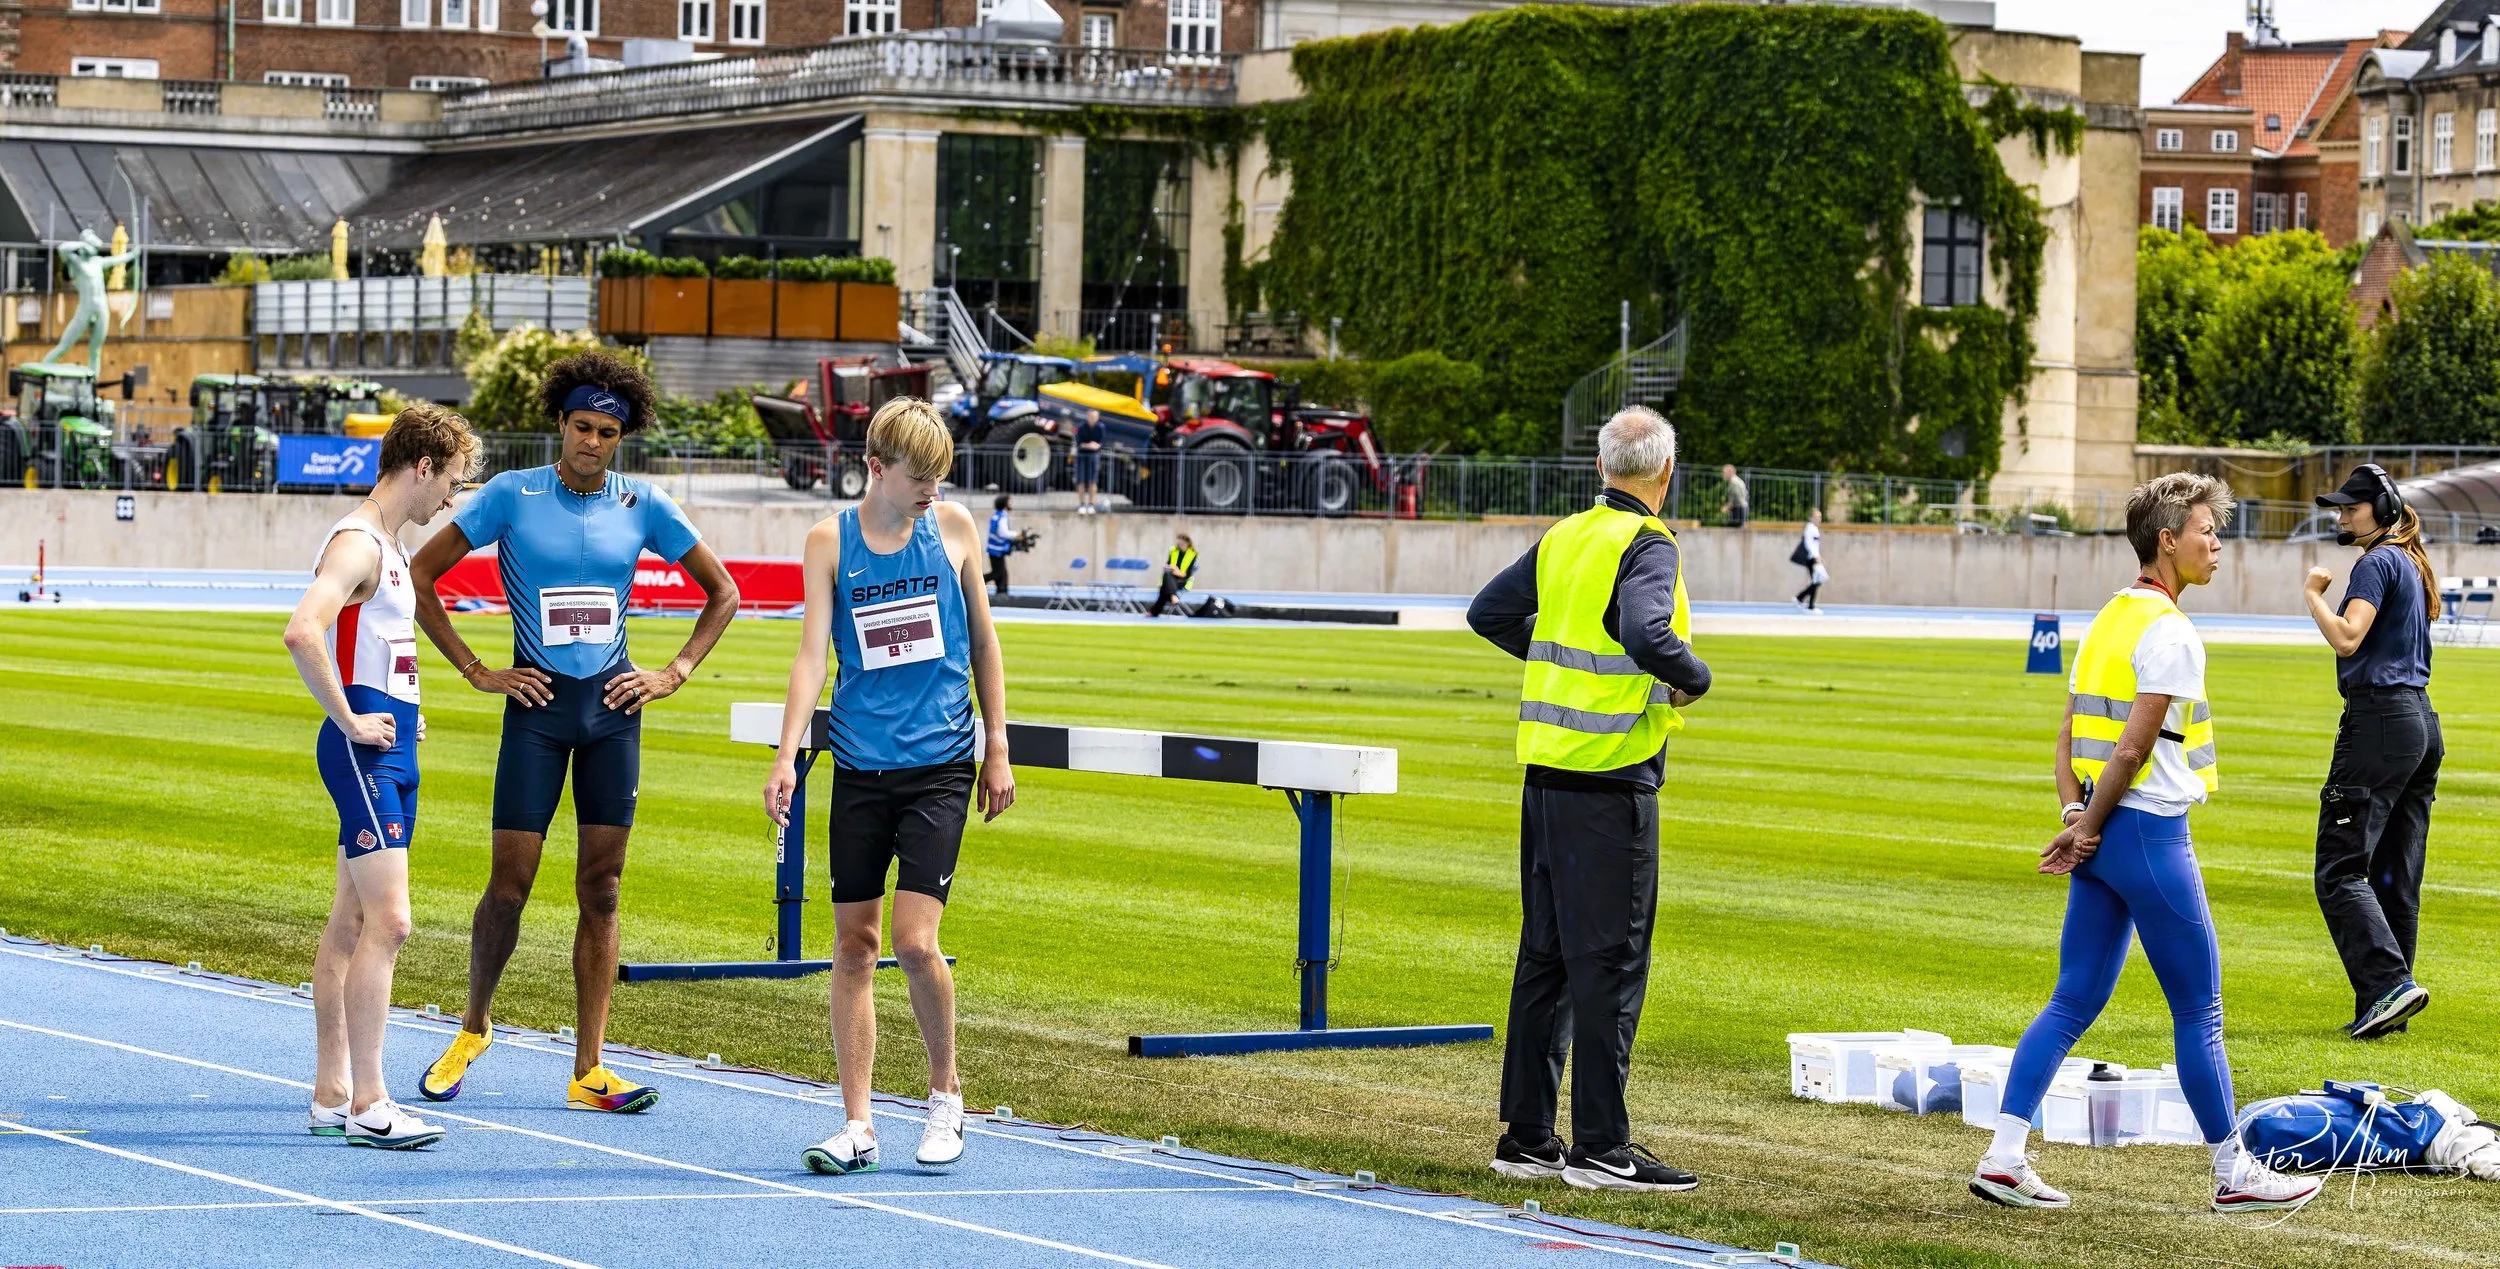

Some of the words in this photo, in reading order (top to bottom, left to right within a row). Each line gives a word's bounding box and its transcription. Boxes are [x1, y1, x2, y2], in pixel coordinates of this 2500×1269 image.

[851, 576, 938, 602] SPARTA
[570, 612, 590, 622] 154
[863, 620, 881, 629] DANSKE
[881, 613, 917, 625] MESTERSKABER
[887, 629, 909, 642] 179
[2032, 630, 2059, 653] 40
[366, 773, 379, 794] CRAFT
